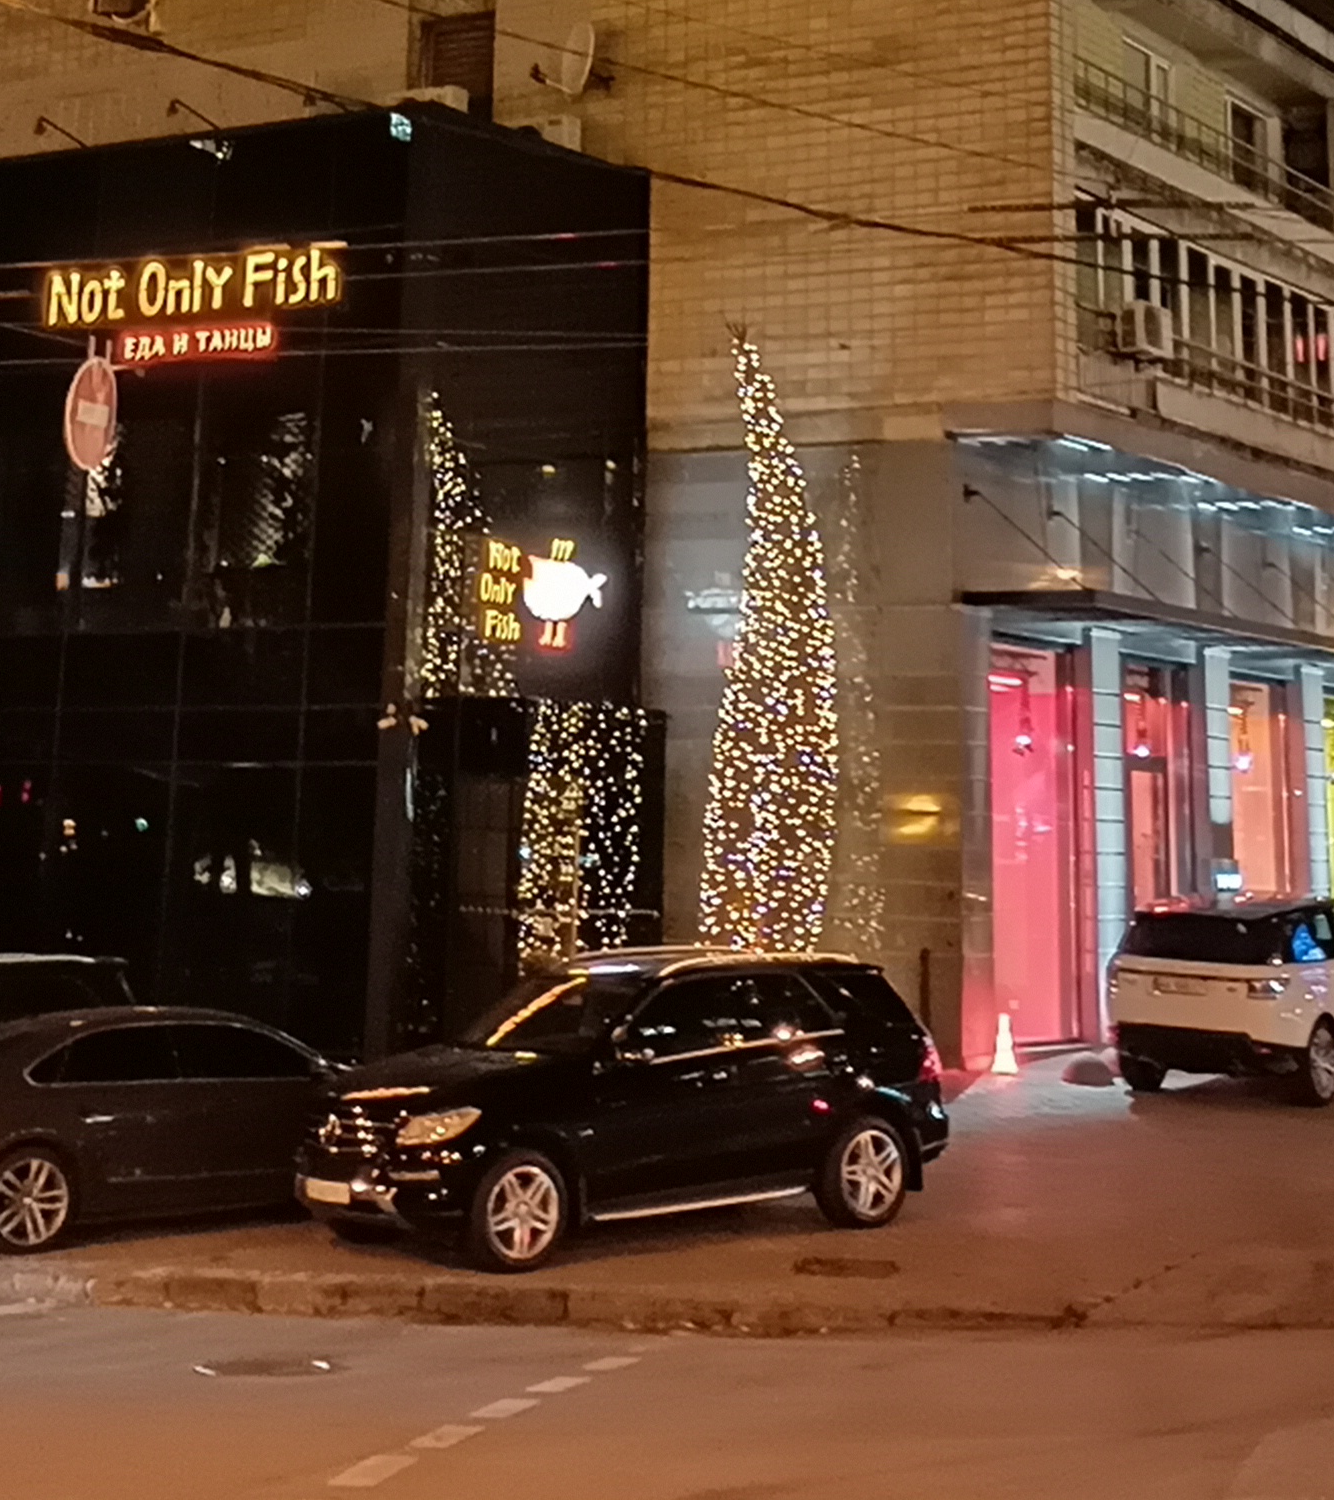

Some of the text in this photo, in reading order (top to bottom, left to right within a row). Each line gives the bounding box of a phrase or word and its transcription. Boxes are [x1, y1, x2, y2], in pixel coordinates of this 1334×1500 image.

[49, 269, 125, 326] Not
[243, 247, 337, 307] Fish
[124, 333, 165, 360] ЕДА
[196, 325, 272, 352] ТАНЦЫ
[489, 540, 521, 573] Not
[485, 609, 520, 640] Fish
